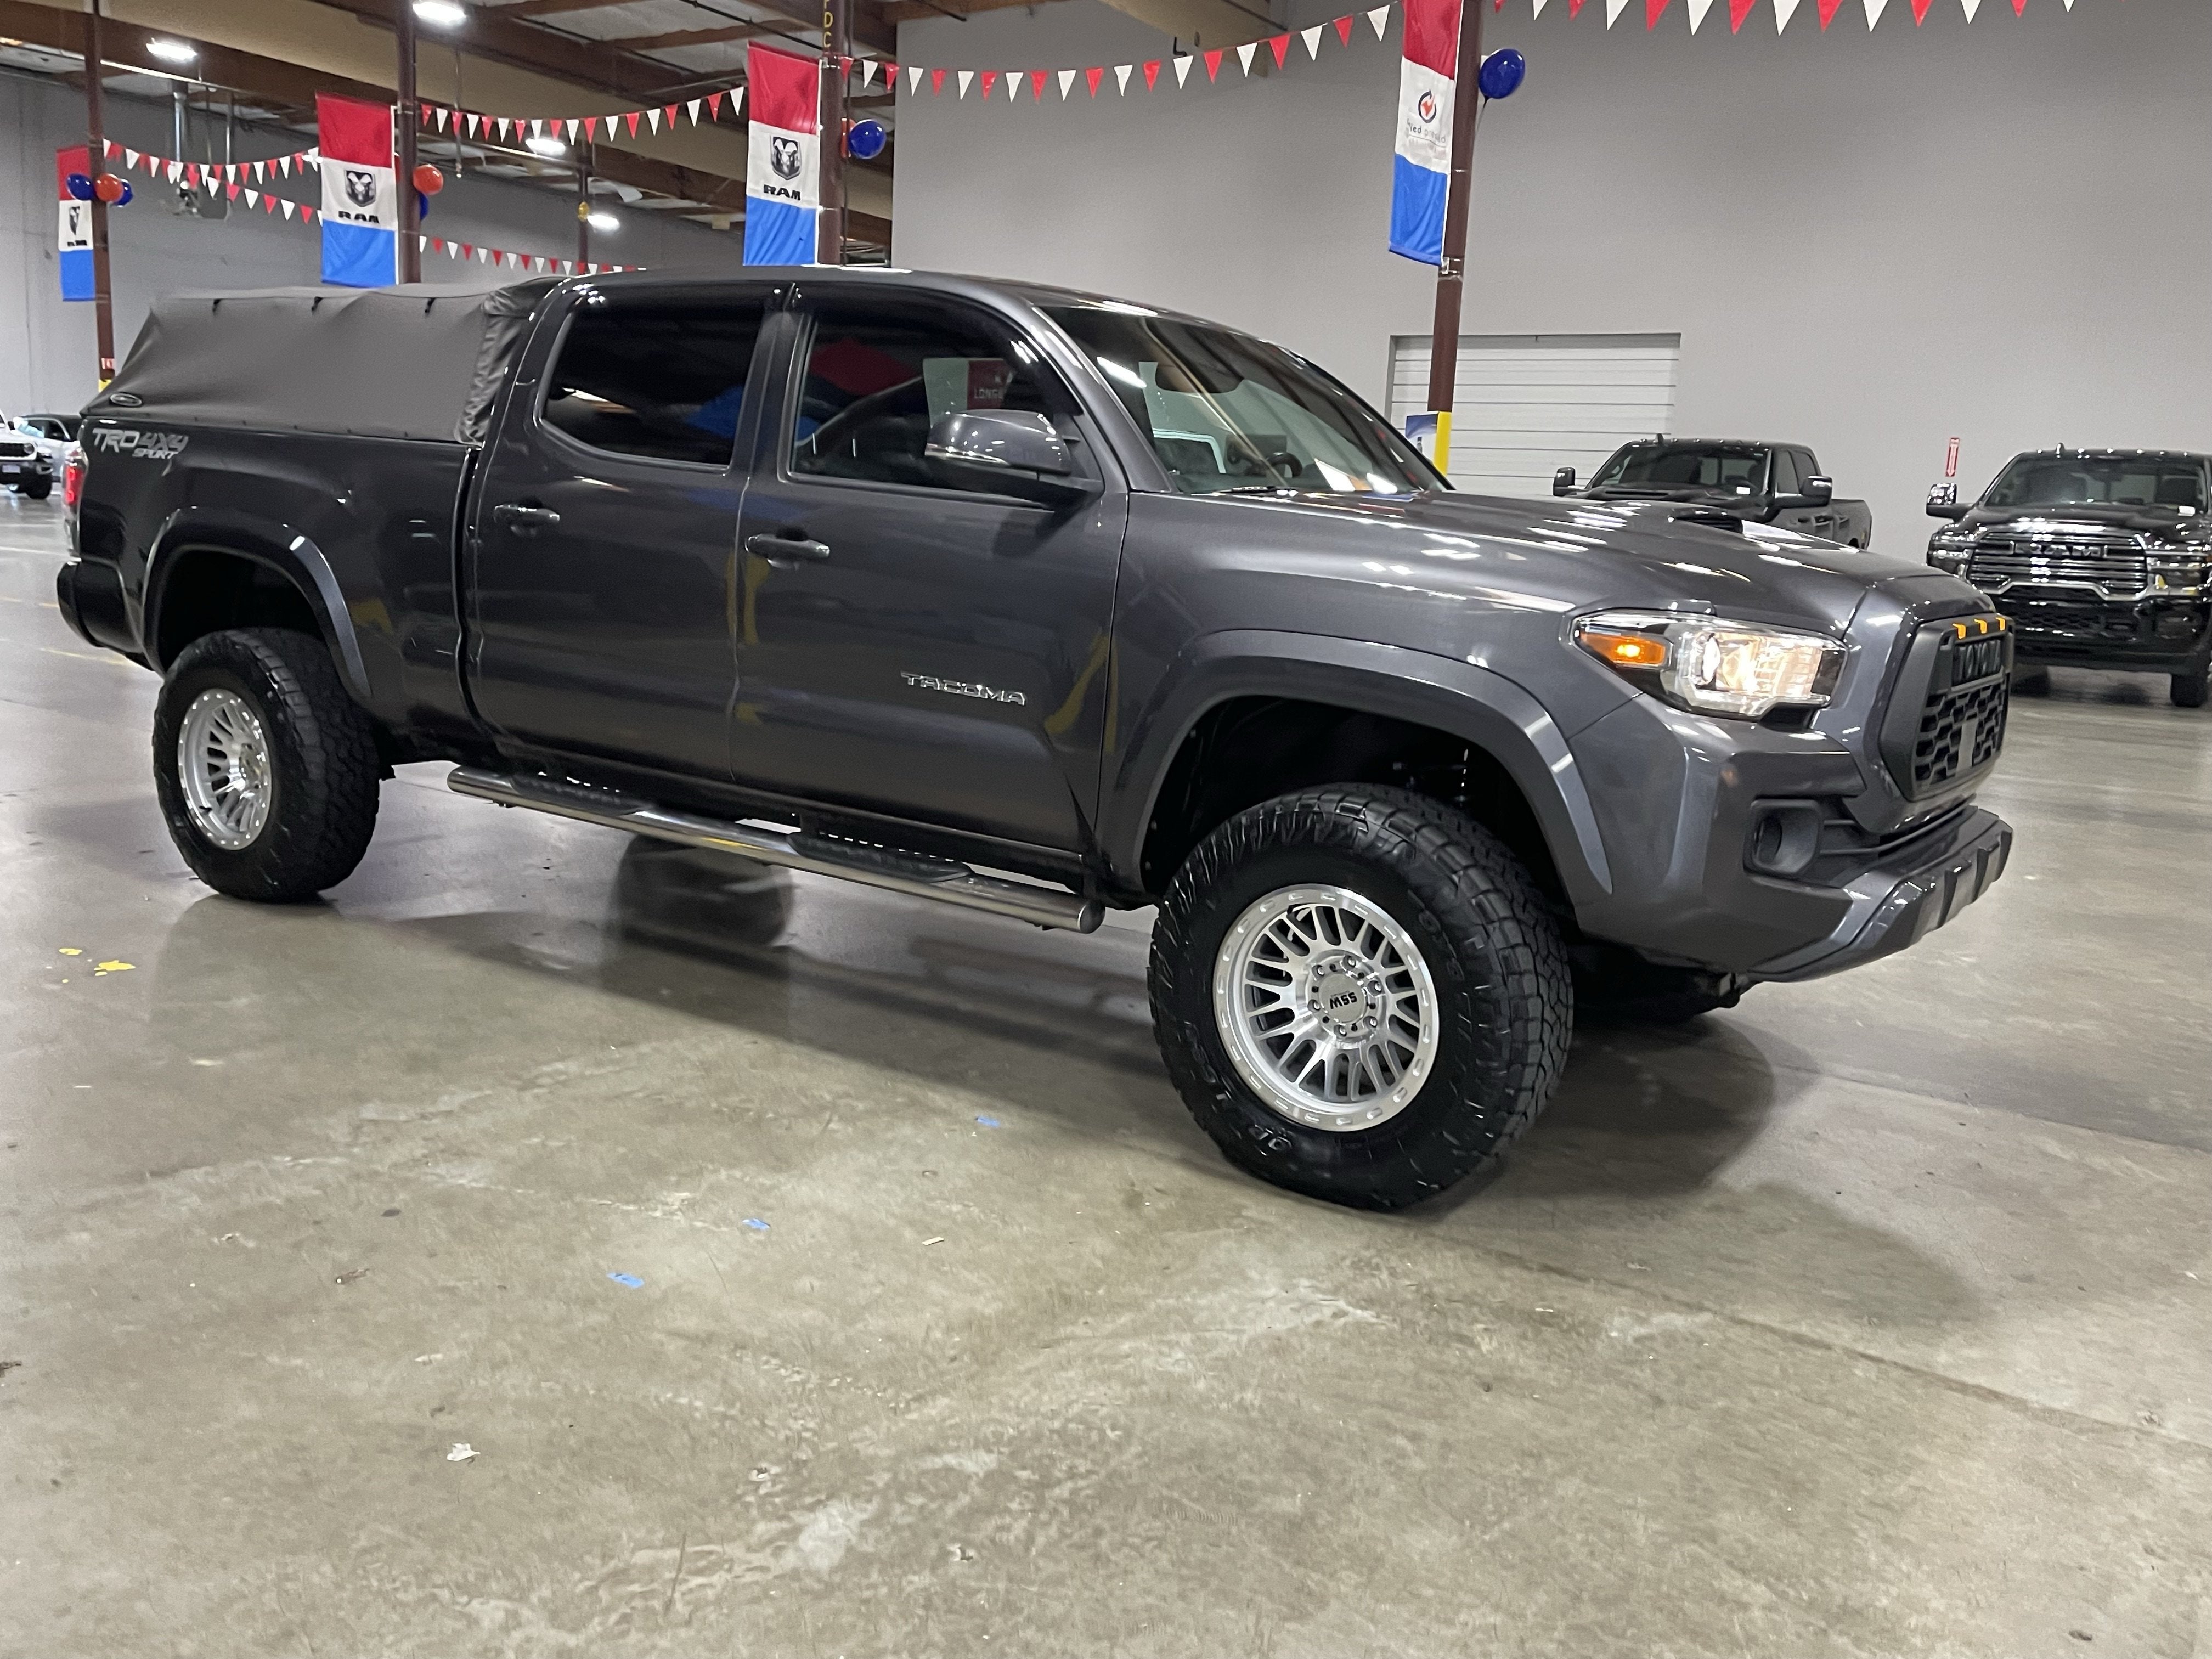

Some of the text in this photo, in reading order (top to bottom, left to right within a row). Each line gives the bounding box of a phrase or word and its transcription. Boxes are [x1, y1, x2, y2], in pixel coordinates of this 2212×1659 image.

[763, 184, 801, 201] RAM
[92, 427, 140, 453] TRD
[132, 447, 179, 460] SPORT
[900, 670, 1027, 706] TACOMA
